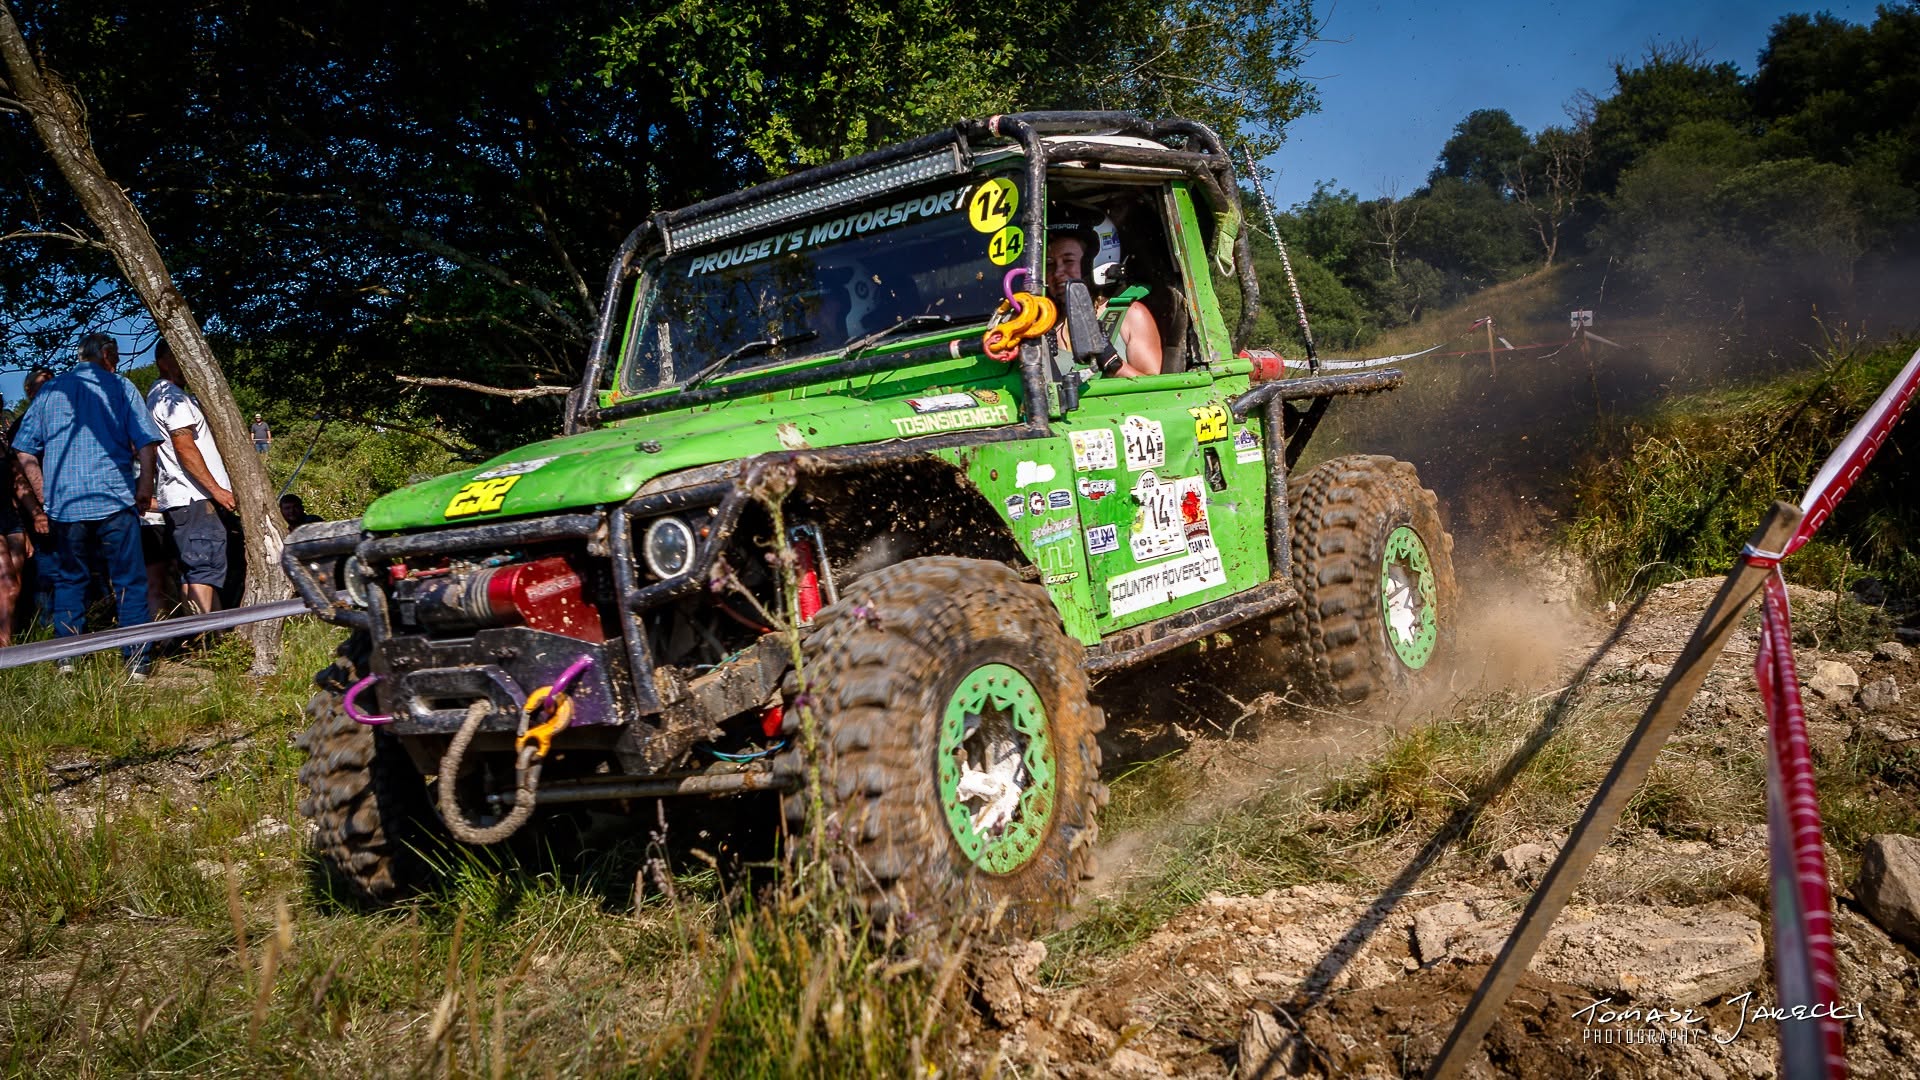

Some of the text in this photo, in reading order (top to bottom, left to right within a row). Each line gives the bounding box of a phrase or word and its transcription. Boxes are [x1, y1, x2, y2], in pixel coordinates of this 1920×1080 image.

[977, 187, 1012, 222] 14
[688, 184, 973, 278] PROUSEY'S MOTORSPORT
[992, 233, 1021, 259] 14
[1135, 434, 1156, 461] 14
[1149, 494, 1171, 530] 14
[1111, 573, 1160, 602] COUNTRY
